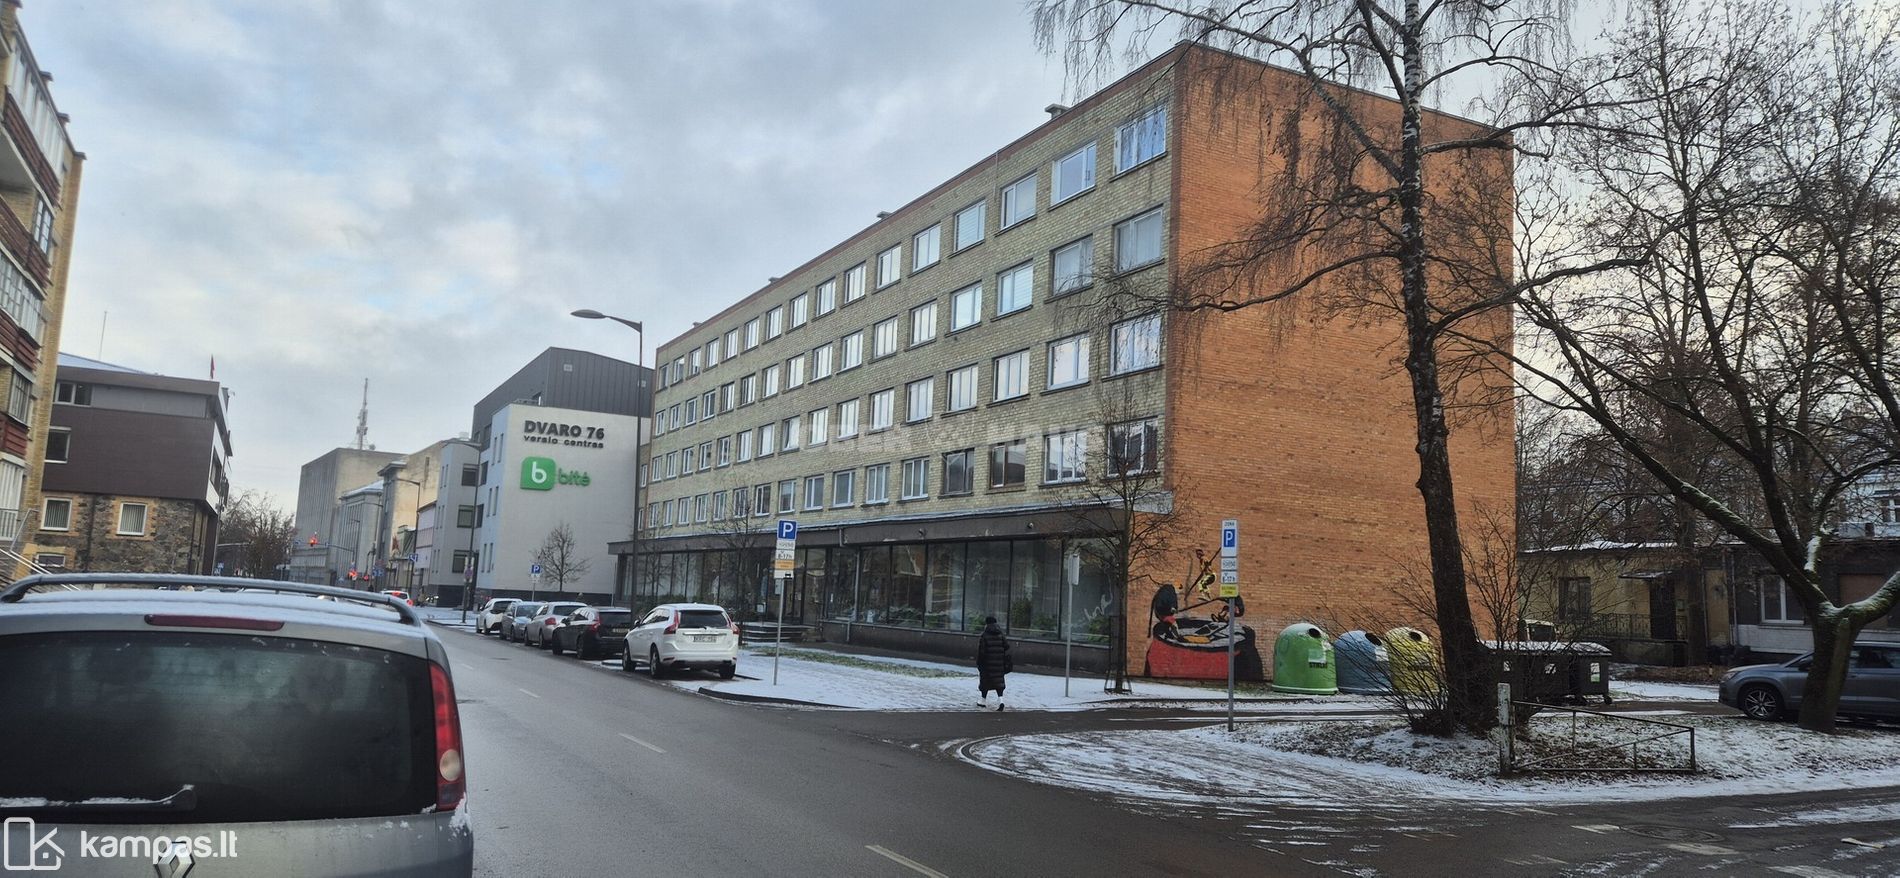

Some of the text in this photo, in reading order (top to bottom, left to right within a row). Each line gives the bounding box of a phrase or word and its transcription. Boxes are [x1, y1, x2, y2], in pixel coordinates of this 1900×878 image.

[524, 420, 604, 440] DVARO 76
[564, 440, 604, 449] centras
[531, 461, 547, 484] b
[783, 522, 793, 537] P
[1225, 531, 1233, 546] P
